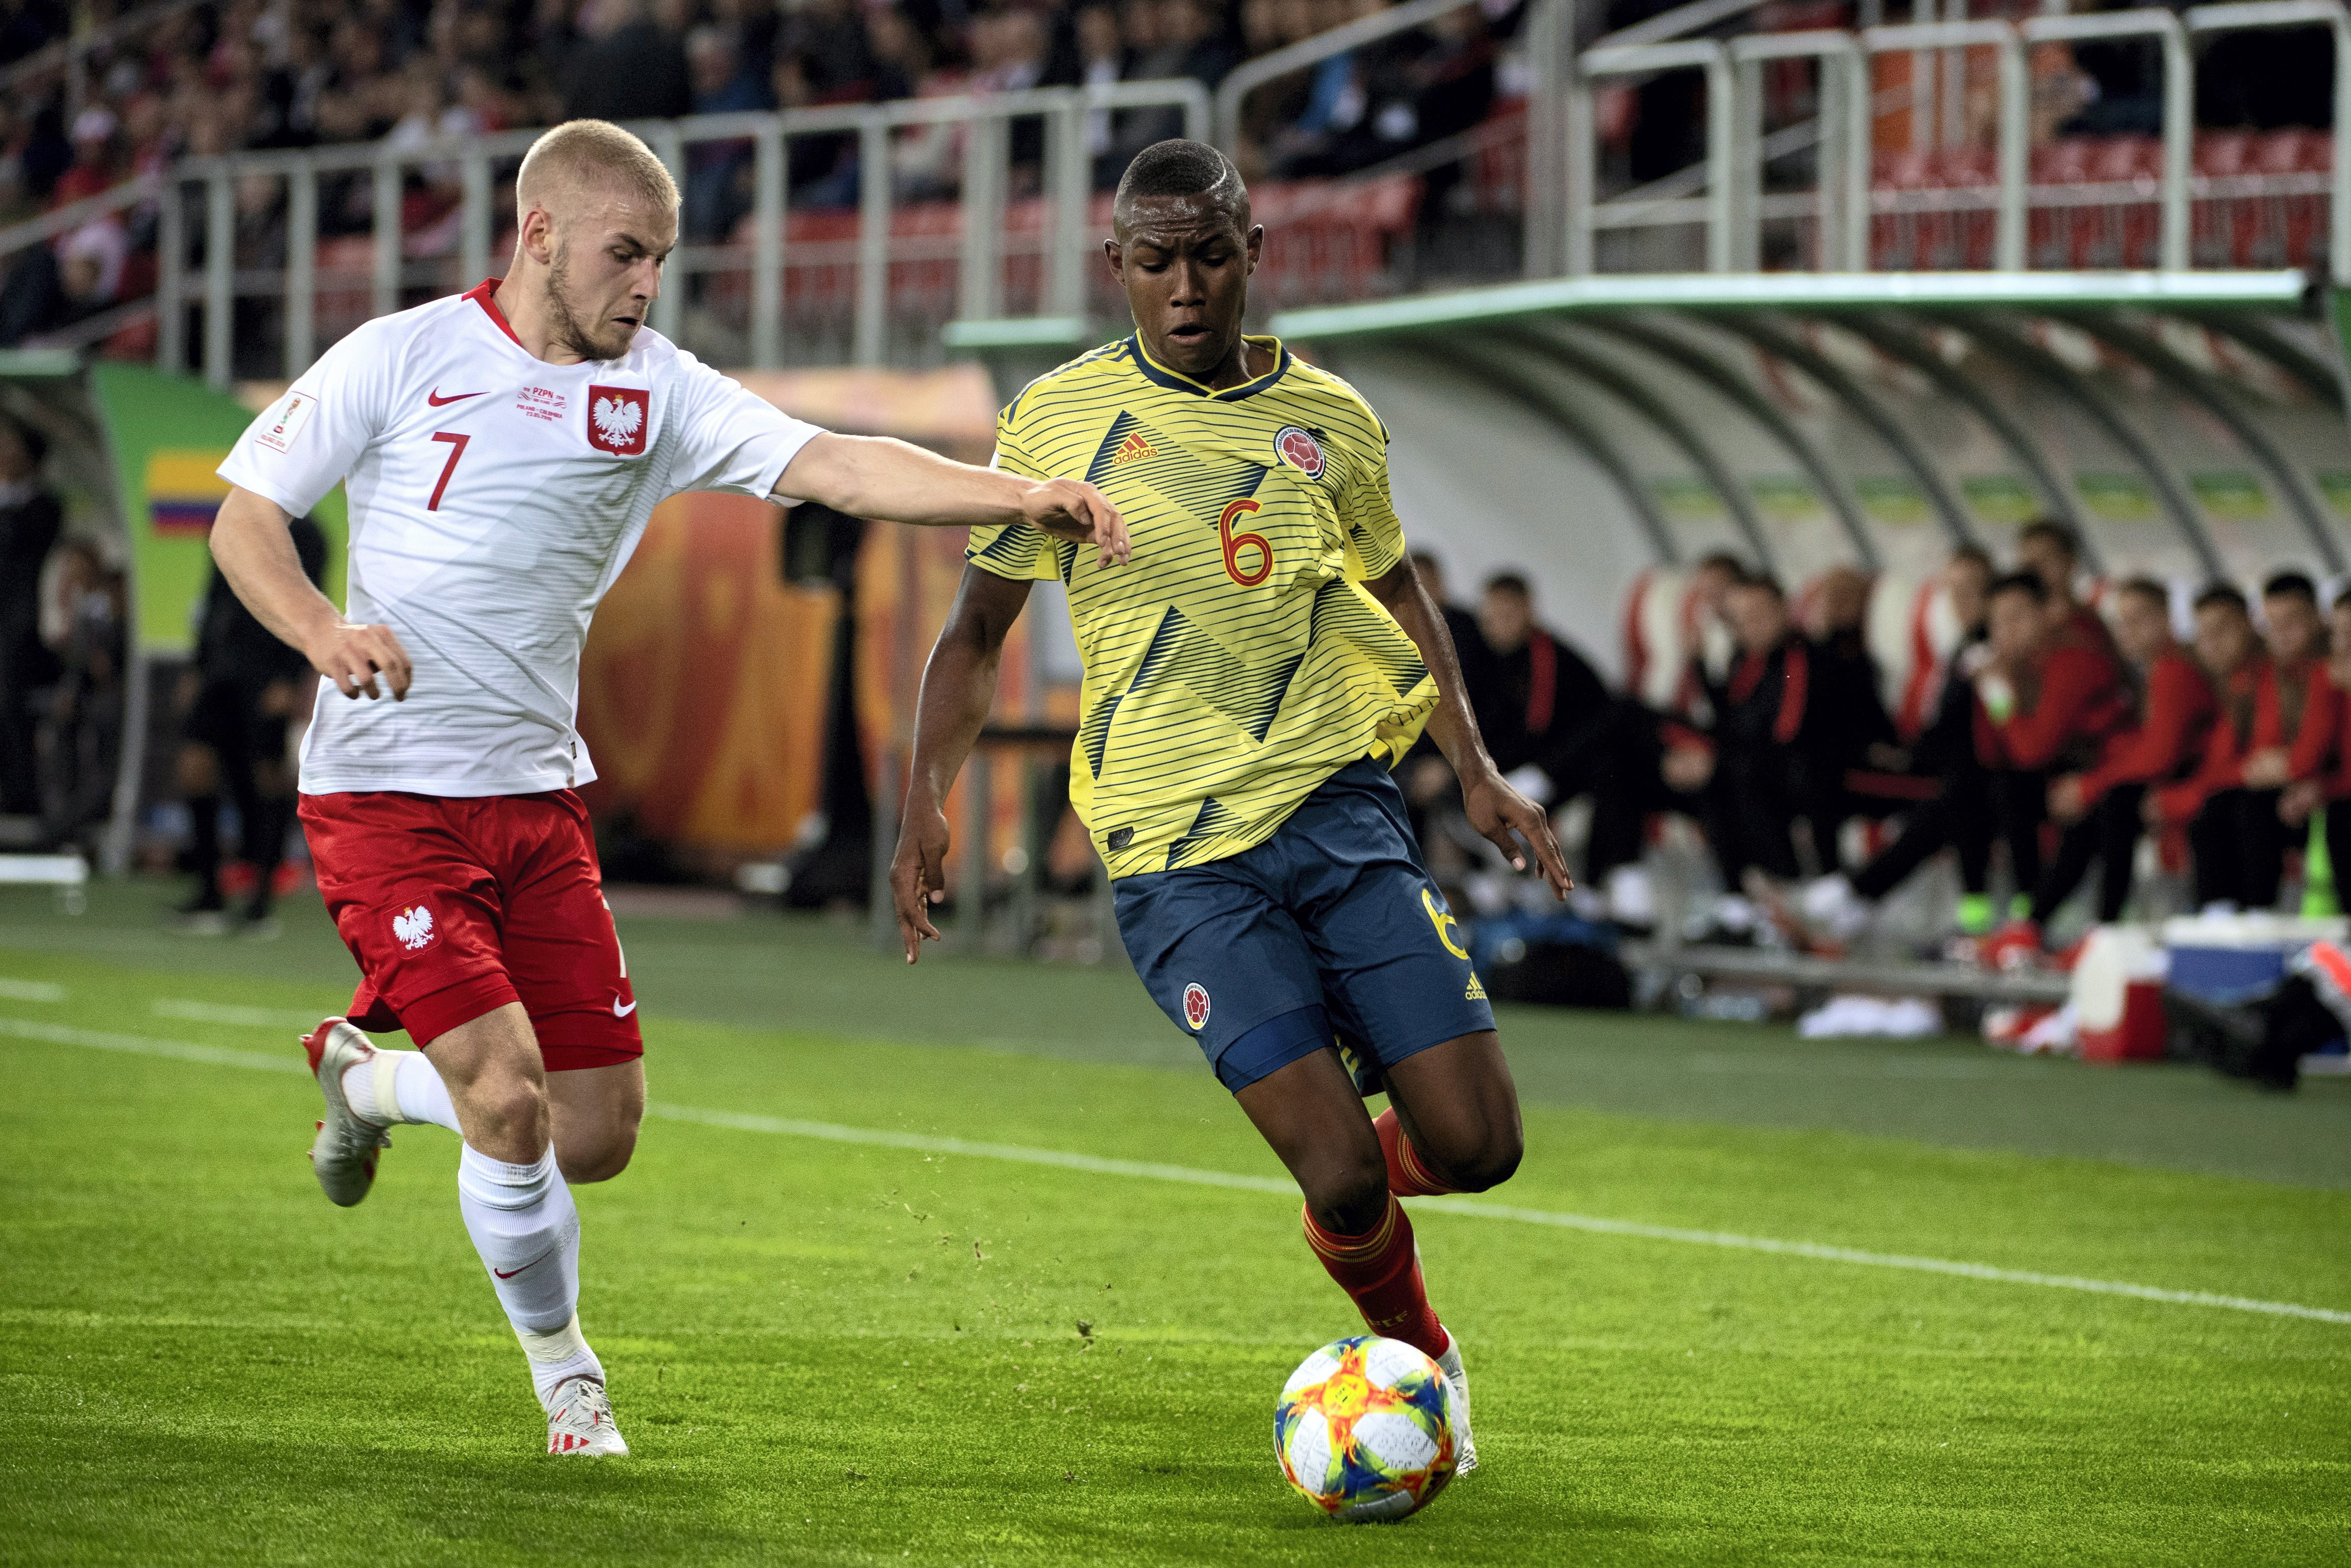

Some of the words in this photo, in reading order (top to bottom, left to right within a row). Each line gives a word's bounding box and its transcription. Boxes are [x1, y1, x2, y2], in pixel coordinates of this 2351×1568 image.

[532, 387, 553, 398] PZPN
[427, 431, 471, 511] 7
[1114, 448, 1158, 465] adidas
[1219, 497, 1275, 587] 6
[1422, 889, 1469, 960] 6
